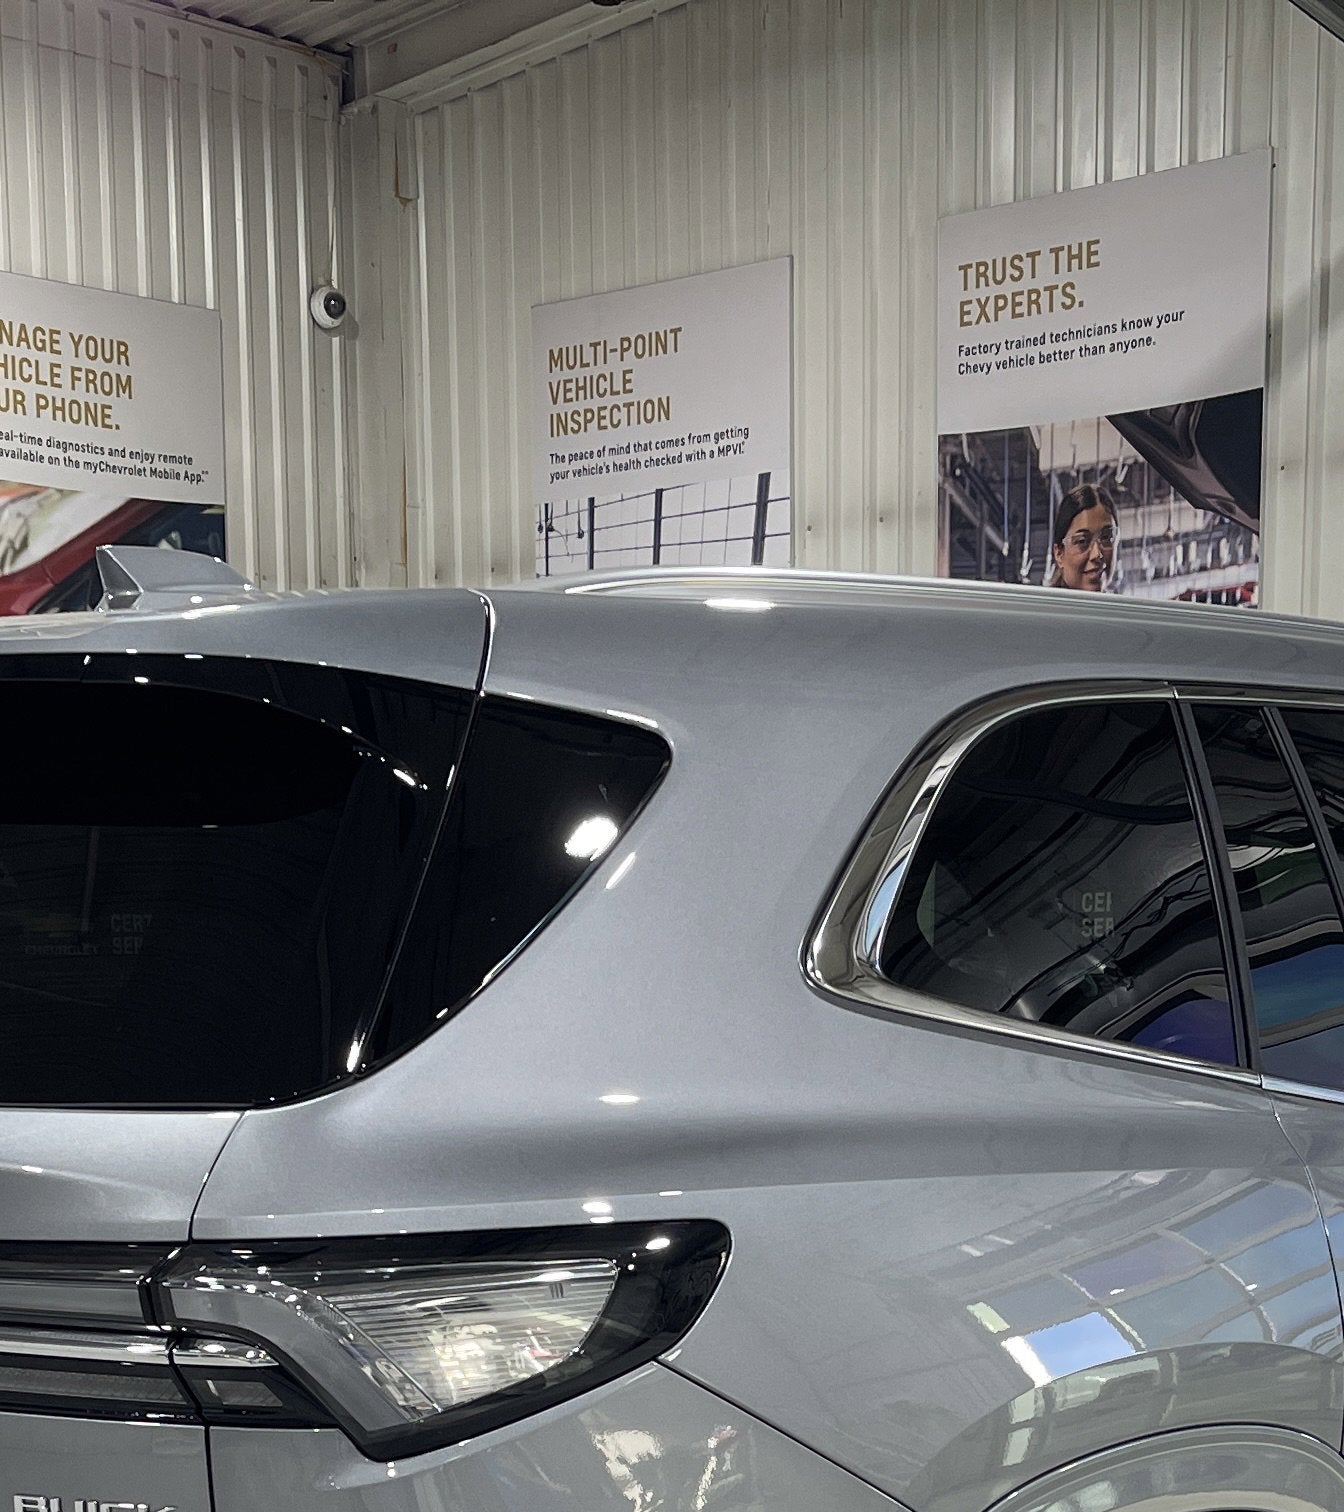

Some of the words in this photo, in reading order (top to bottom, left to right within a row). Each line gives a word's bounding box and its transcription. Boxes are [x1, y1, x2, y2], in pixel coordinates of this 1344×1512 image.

[958, 250, 1042, 291] TRUST
[1049, 238, 1101, 275] THE
[959, 281, 1085, 328] EXPERTS.
[68, 332, 131, 367] YOUR
[549, 326, 682, 374] MULTI-POINT
[958, 339, 1002, 358] Factory
[1004, 332, 1046, 351] trained
[1049, 321, 1118, 344] technicians
[1120, 314, 1154, 332] know
[1155, 310, 1185, 329] your
[958, 359, 993, 376] Chevy
[995, 352, 1036, 369] vehicle
[1038, 347, 1076, 364] better
[1078, 342, 1106, 357] than
[1109, 335, 1157, 354] anyone.
[70, 365, 133, 400] FROM
[548, 368, 634, 405] VEHICLE
[35, 392, 121, 431] PHONE.
[550, 396, 671, 438] INSPECTION
[46, 436, 105, 457] diagnostics
[108, 445, 126, 459] and
[129, 448, 156, 465] enjoy
[157, 451, 194, 466] remote
[550, 452, 566, 465] The
[568, 449, 594, 466] peace
[596, 445, 607, 458] of
[608, 442, 631, 457] mind
[633, 440, 653, 452] that
[655, 437, 686, 450] comes
[687, 432, 711, 447] from
[713, 425, 750, 445] getting
[48, 455, 61, 467] on
[63, 455, 80, 469] the
[83, 459, 147, 478] myChevrolet
[149, 465, 181, 482] Mobile
[550, 469, 570, 485] your
[612, 457, 642, 473] health
[644, 452, 683, 468] checked
[685, 448, 706, 462] with
[708, 450, 716, 459] a
